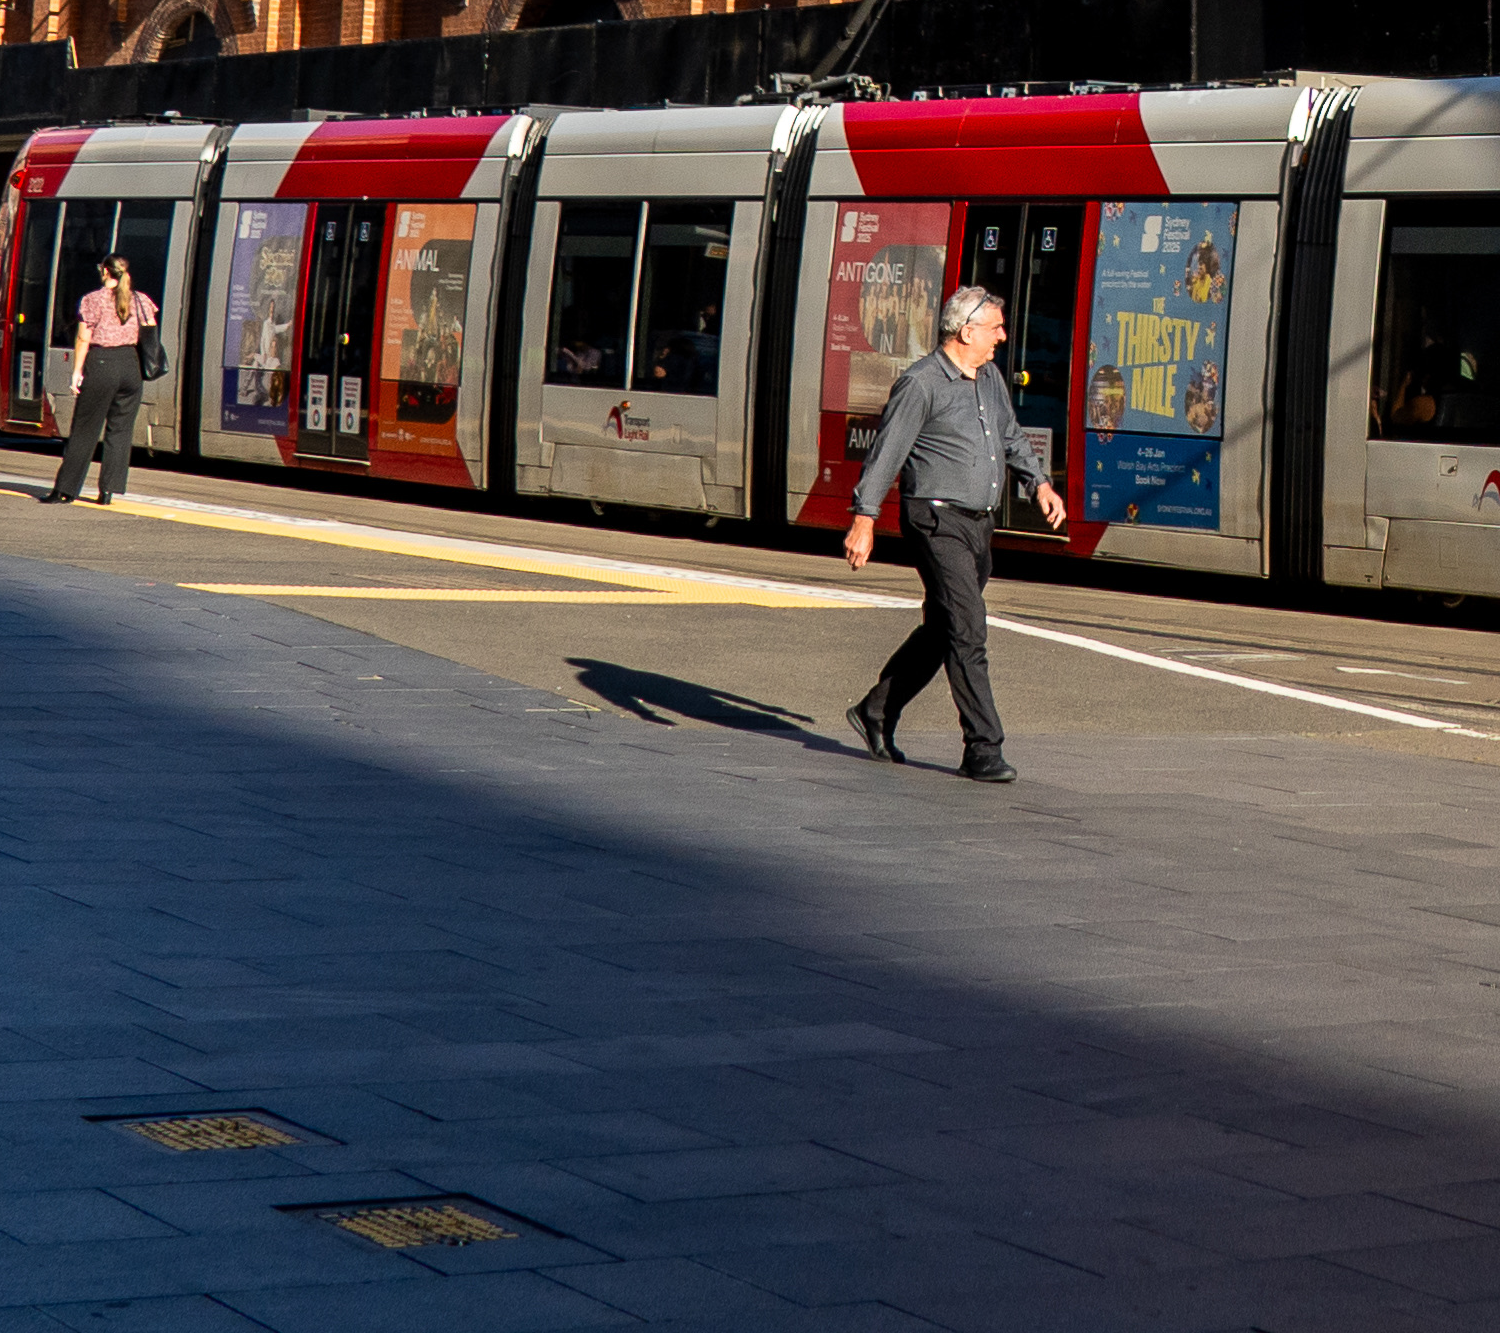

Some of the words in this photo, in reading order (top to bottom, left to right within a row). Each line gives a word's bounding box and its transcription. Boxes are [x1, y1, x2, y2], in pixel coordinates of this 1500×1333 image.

[1165, 216, 1191, 229] Sydney
[1163, 229, 1191, 240] Festival
[1162, 241, 1181, 252] 2025
[394, 249, 440, 271] ANIMAL
[836, 261, 904, 284] ANTIGONE
[1152, 297, 1166, 314] THE
[880, 334, 894, 354] IN
[1117, 311, 1201, 366] THIRSTY
[1131, 364, 1177, 418] MILE
[624, 414, 651, 427] Transport
[1154, 448, 1165, 458] Jan
[1135, 474, 1150, 484] Book
[1151, 475, 1166, 485] Now
